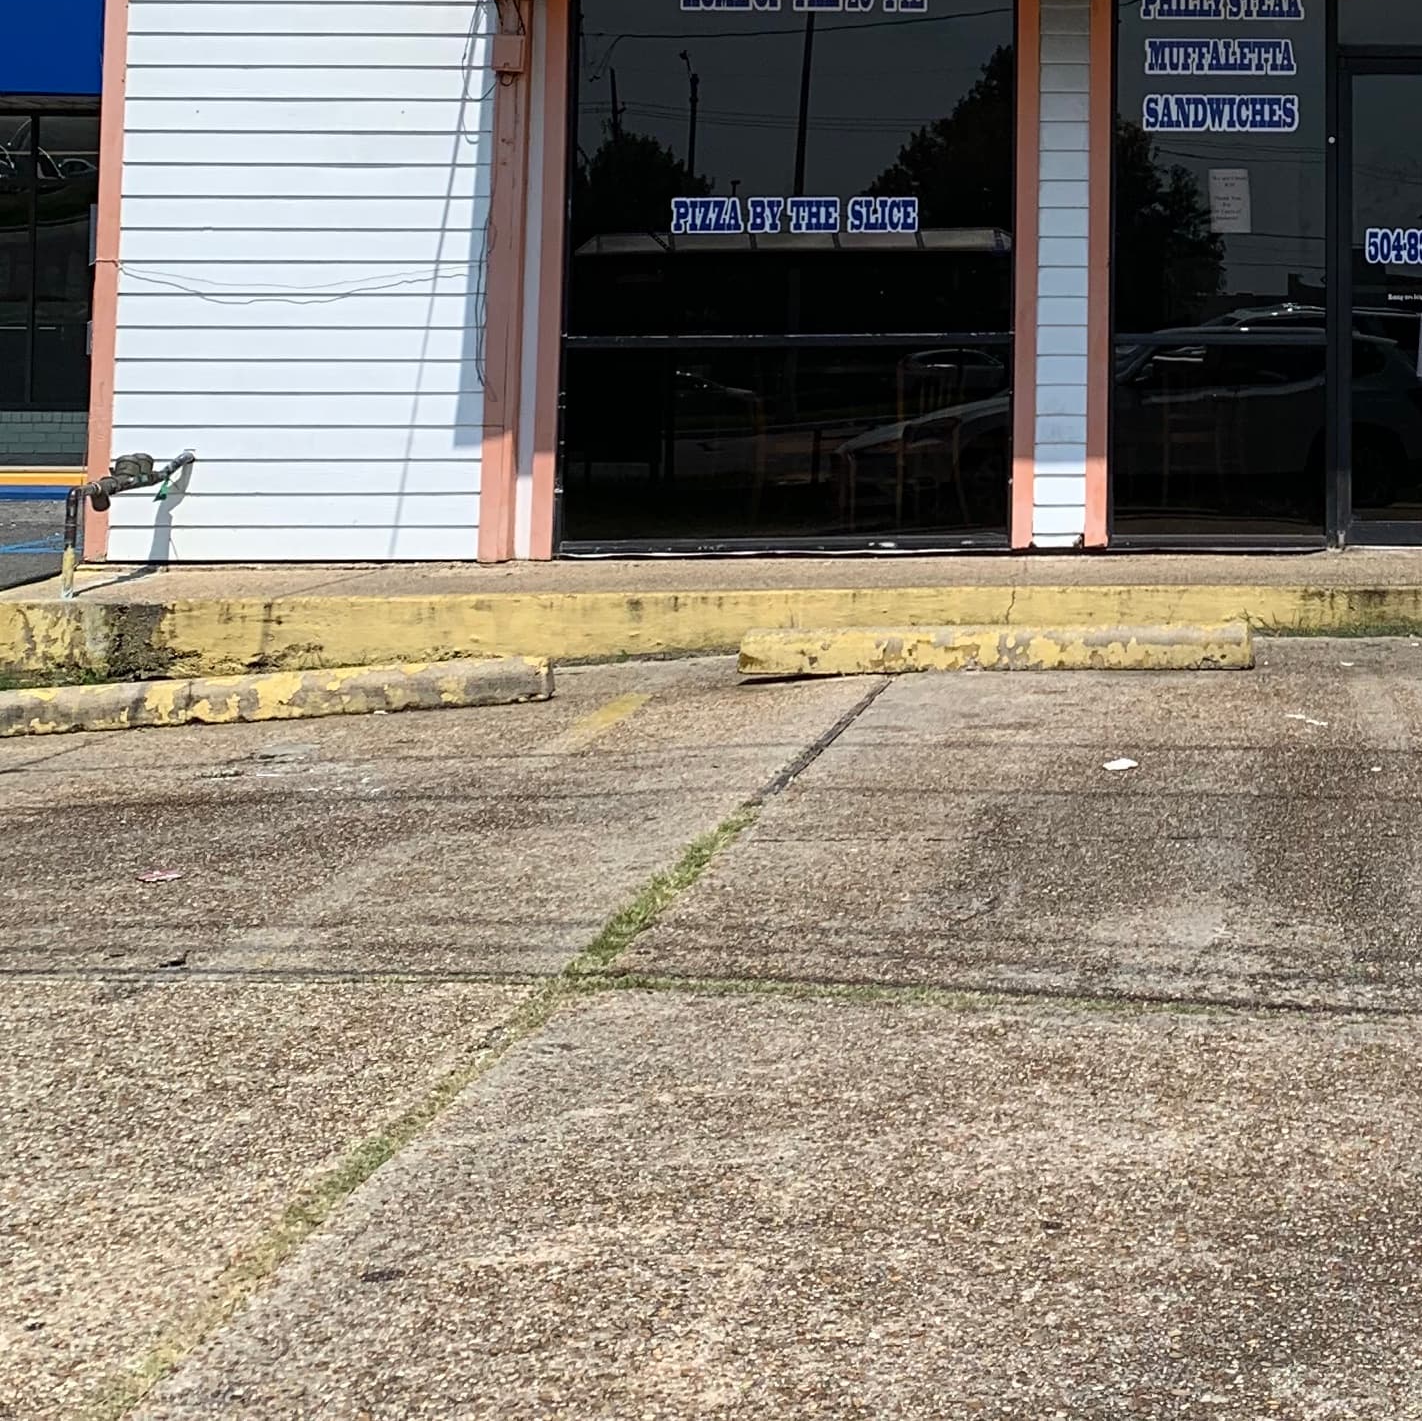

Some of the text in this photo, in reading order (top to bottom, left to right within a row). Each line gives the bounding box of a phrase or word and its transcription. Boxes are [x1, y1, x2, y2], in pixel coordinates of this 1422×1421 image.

[1145, 39, 1296, 75] MUFFALETTA
[1143, 94, 1299, 132] SANDWICHES
[671, 197, 918, 233] PIZZA BY THE SLICE
